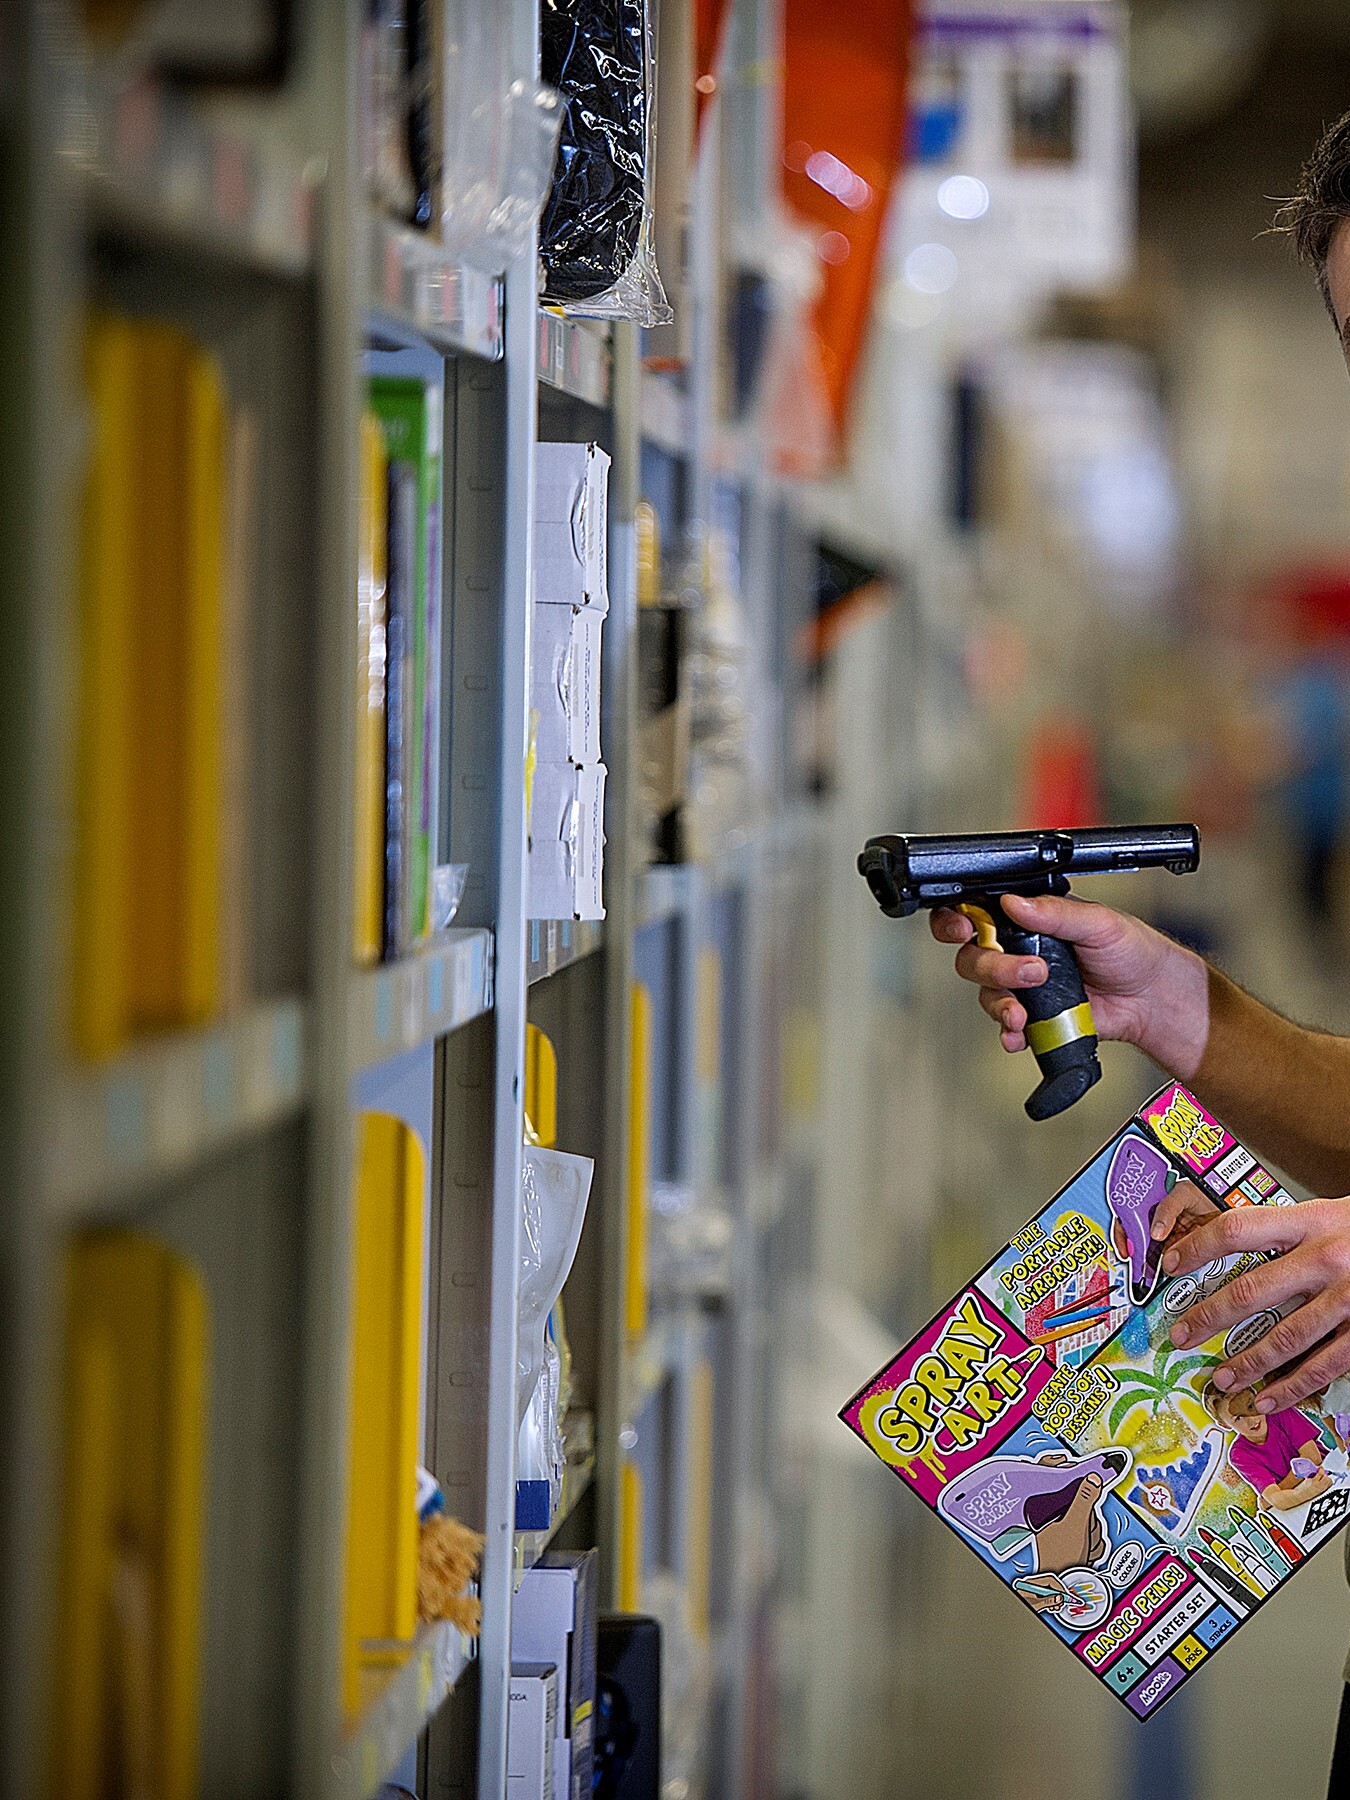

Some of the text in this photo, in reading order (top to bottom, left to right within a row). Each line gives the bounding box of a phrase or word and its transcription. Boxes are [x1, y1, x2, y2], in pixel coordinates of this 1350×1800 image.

[1160, 1090, 1202, 1147] SPRAY
[1191, 1124, 1220, 1155] ART
[1111, 1152, 1145, 1205] SPRAY
[1220, 1157, 1244, 1180] STARTER
[1238, 1151, 1251, 1166] SET
[1128, 1174, 1155, 1209] ART
[1212, 1178, 1224, 1190] 6+
[1011, 1222, 1044, 1251] THE
[1001, 1216, 1088, 1290] PORTABLE
[879, 1295, 1002, 1452] SPRAY
[1077, 1371, 1095, 1392] OF
[938, 1354, 1027, 1447] ART
[1033, 1364, 1075, 1416] CREATE
[963, 1472, 1012, 1520] SPRAY
[979, 1499, 1017, 1525] ART
[1112, 1550, 1132, 1576] CHANGES
[1119, 1557, 1138, 1582] COLOUR!
[1134, 1564, 1185, 1614] PENS!
[1145, 1592, 1206, 1655] STARTER SET
[1209, 1619, 1218, 1628] 3
[1209, 1619, 1232, 1643] STENCILS
[1183, 1645, 1190, 1653] 5
[1185, 1647, 1203, 1666] PENS
[1116, 1666, 1135, 1683] 6+
